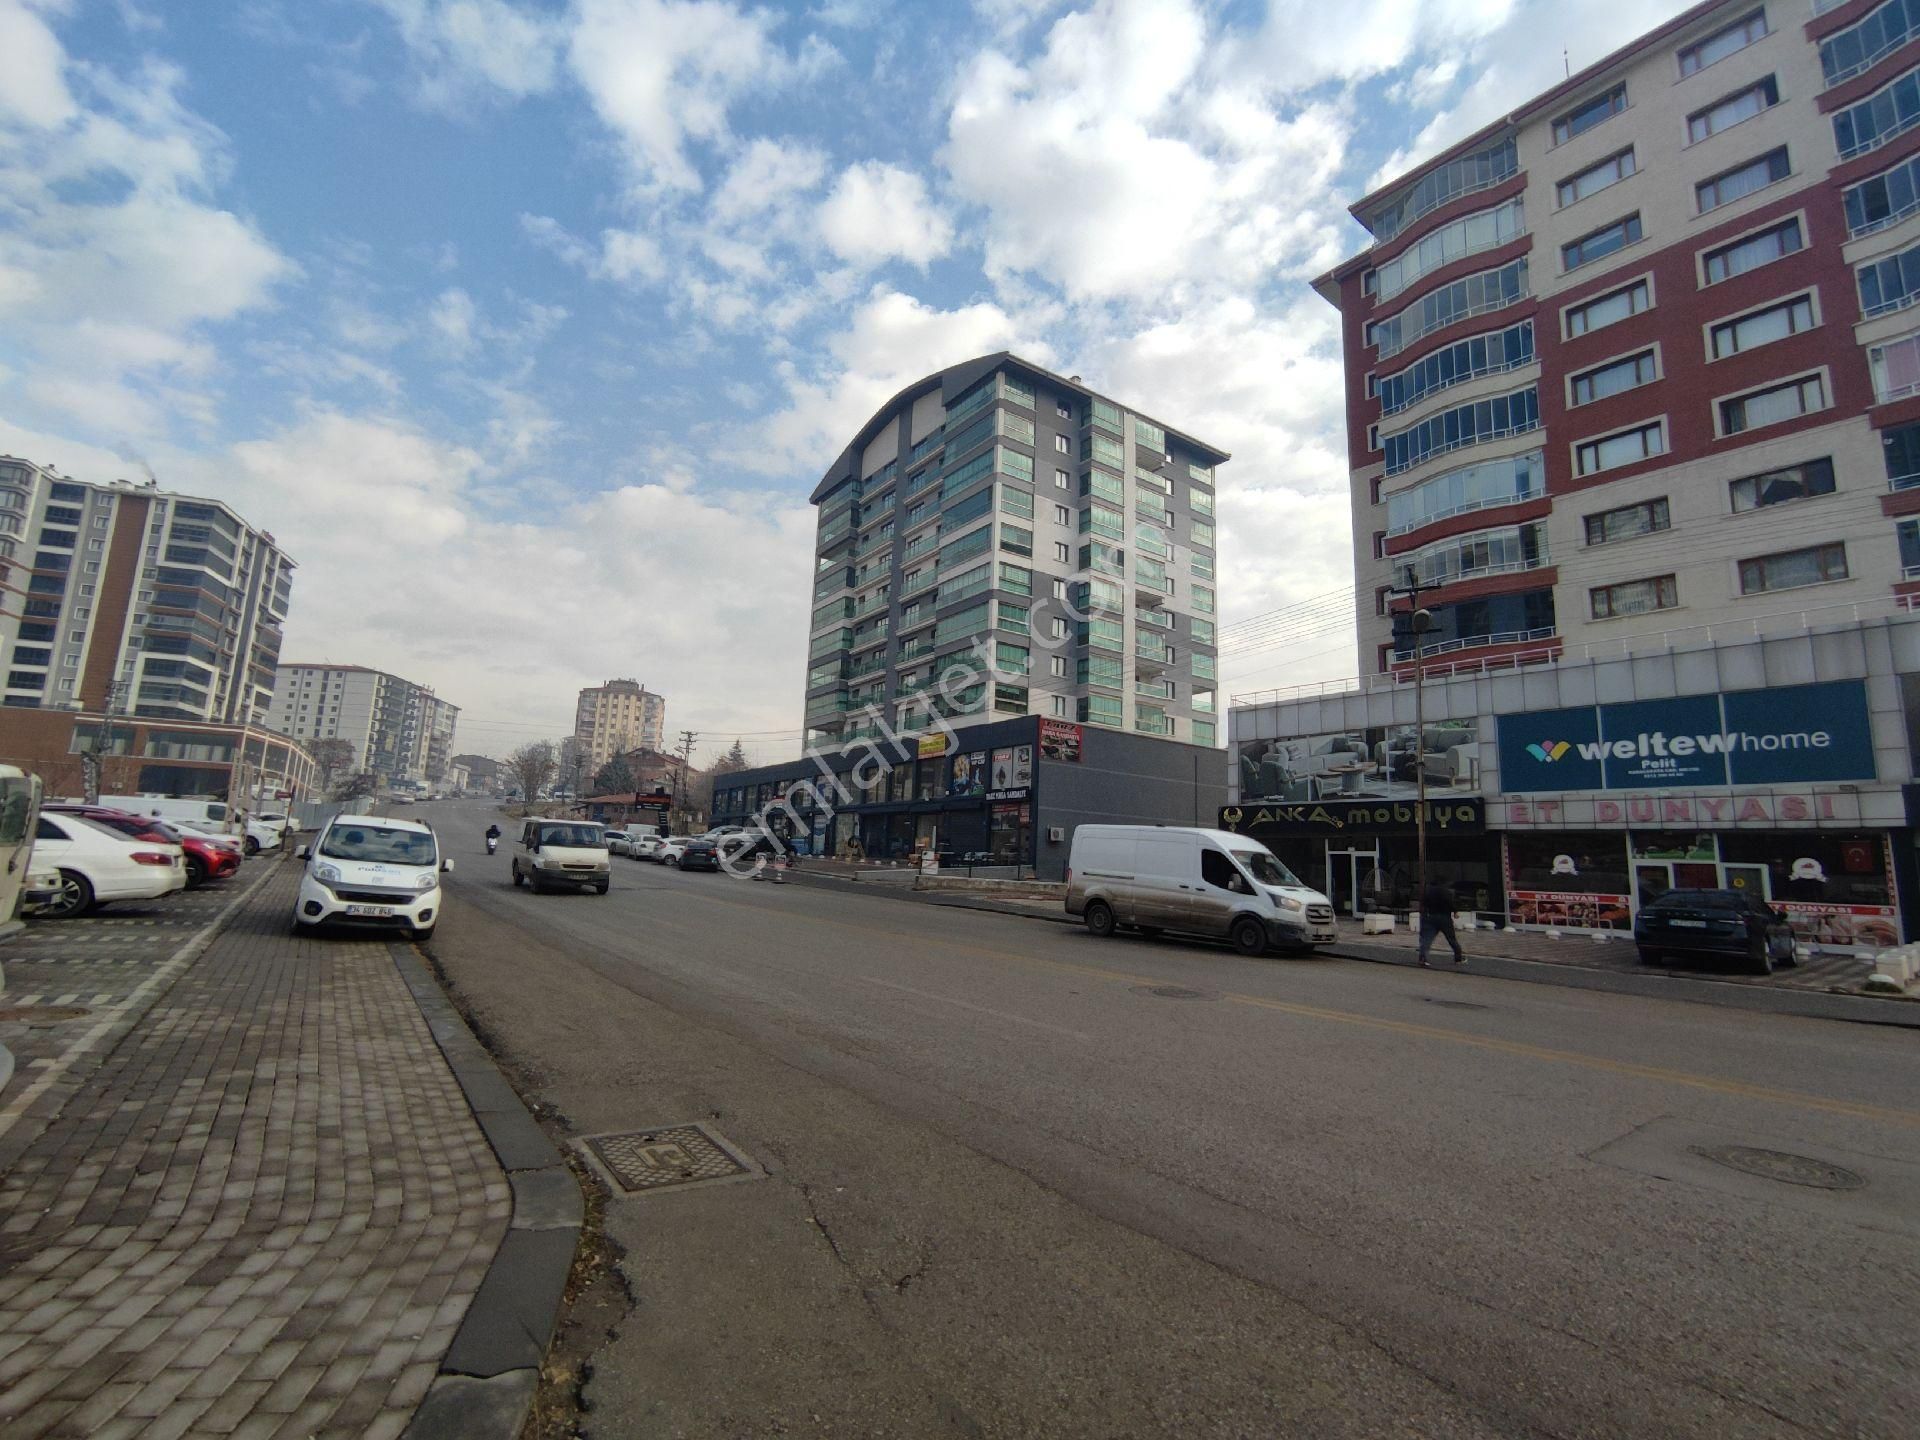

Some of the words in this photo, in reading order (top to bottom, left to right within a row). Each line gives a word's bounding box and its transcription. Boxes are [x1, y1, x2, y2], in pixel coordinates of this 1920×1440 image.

[1642, 758, 1677, 769] Pelit
[1249, 806, 1343, 829] ANKA
[1348, 801, 1475, 828] mobilya
[1509, 801, 1559, 824] ET
[1599, 794, 1836, 822] DÜNYASI
